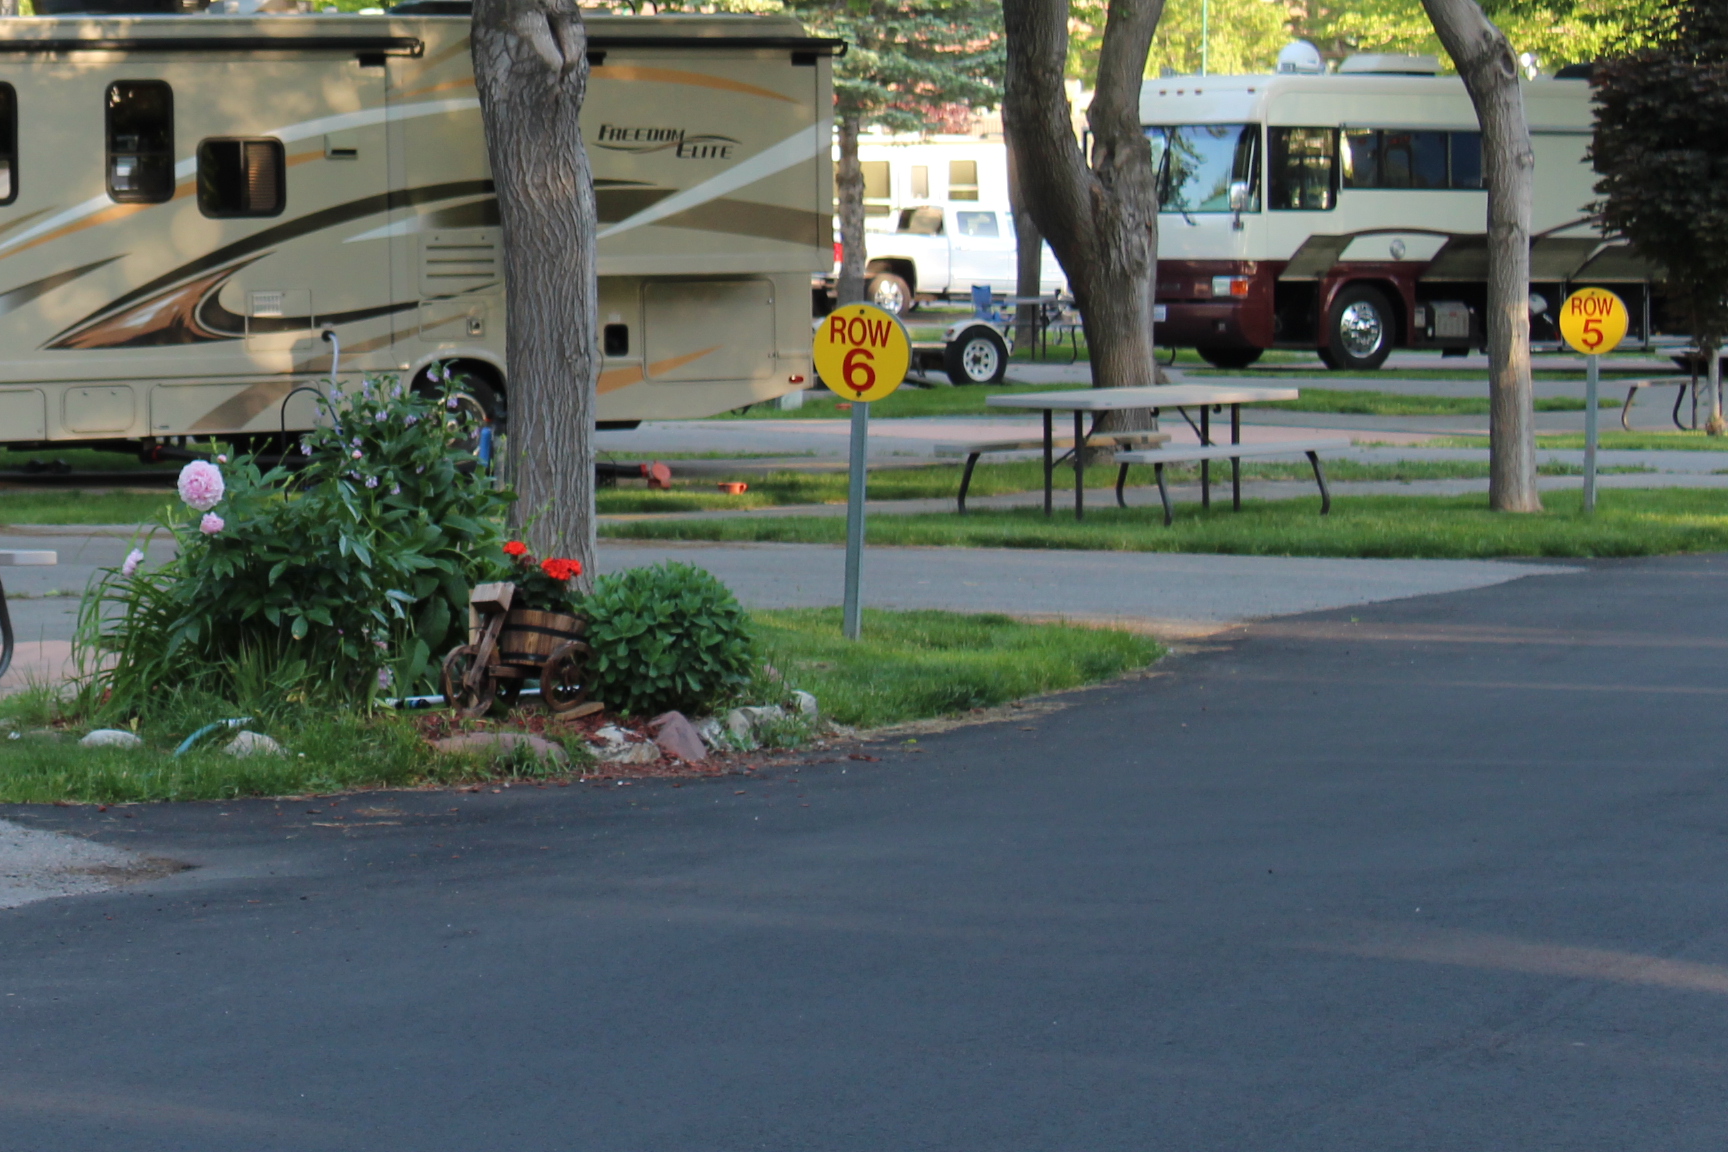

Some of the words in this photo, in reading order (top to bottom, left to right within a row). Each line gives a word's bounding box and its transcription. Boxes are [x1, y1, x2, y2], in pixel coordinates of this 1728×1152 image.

[598, 123, 686, 142] FREEDOM
[675, 141, 734, 160] ELITE
[1571, 296, 1614, 317] ROW
[829, 315, 892, 348] ROW
[1581, 319, 1604, 348] 5
[842, 348, 876, 392] 6
